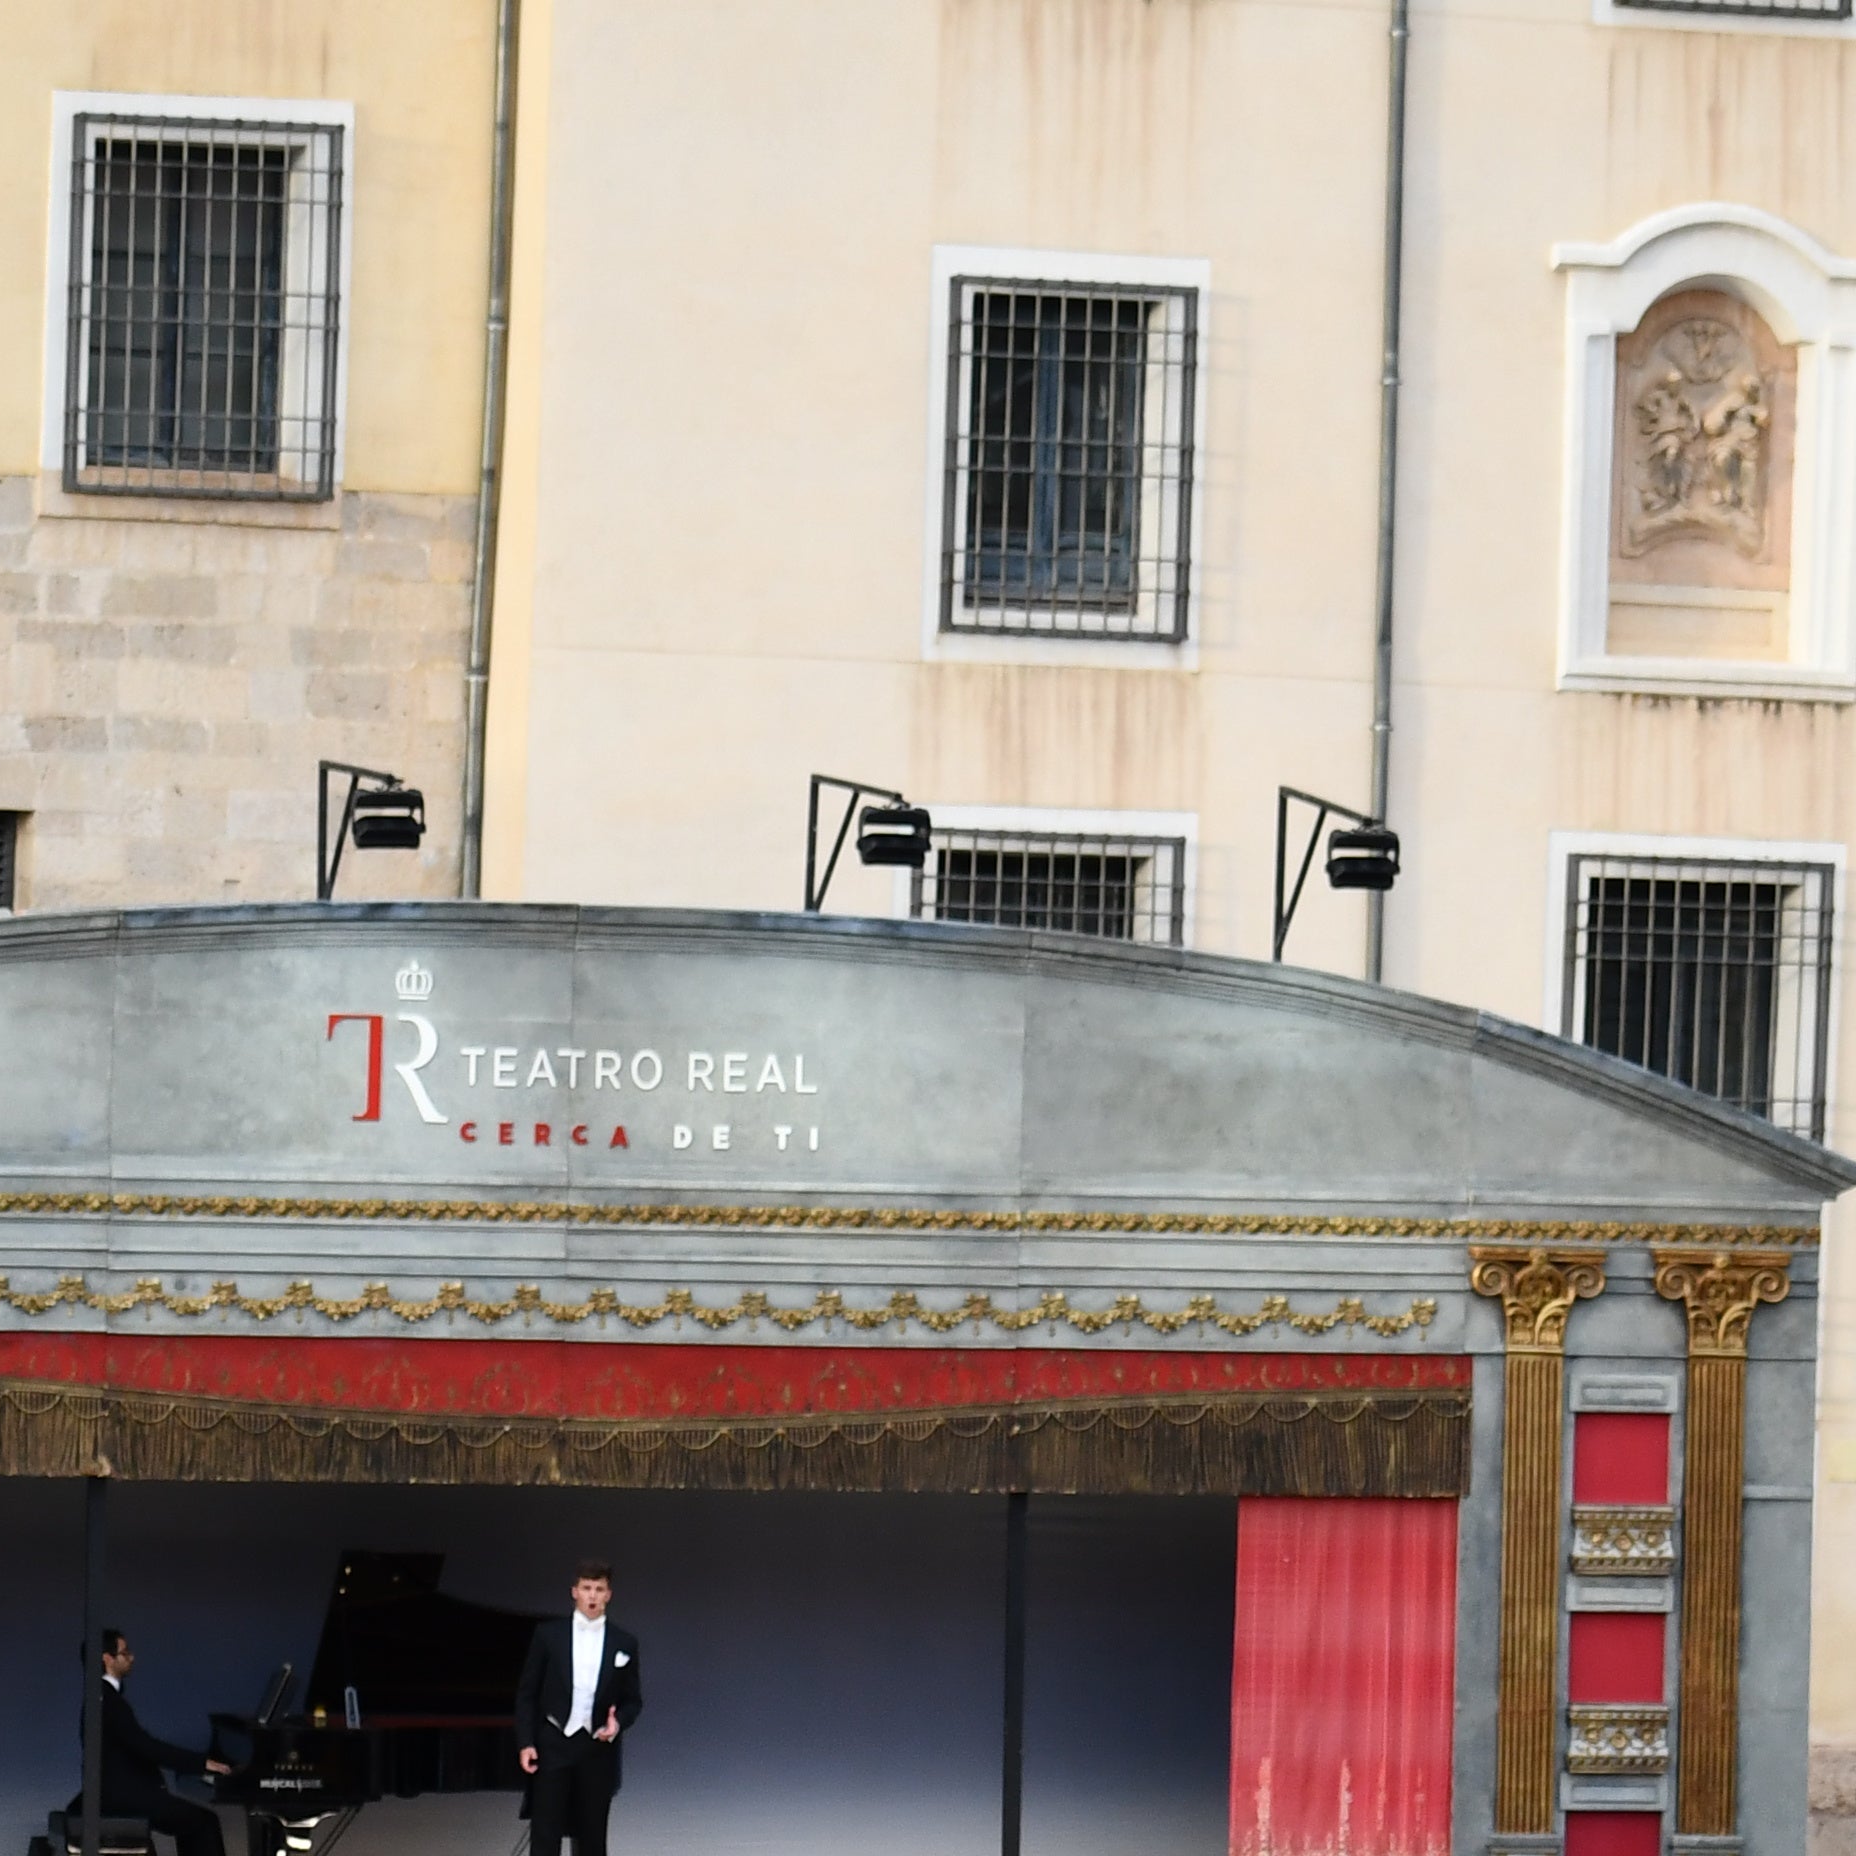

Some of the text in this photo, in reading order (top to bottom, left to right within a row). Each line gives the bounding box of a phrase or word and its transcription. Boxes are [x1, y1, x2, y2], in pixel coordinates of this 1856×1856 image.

[460, 1046, 663, 1091] TEATRO
[687, 1052, 819, 1095] REAL
[459, 1120, 819, 1151] CERCA DE TI
